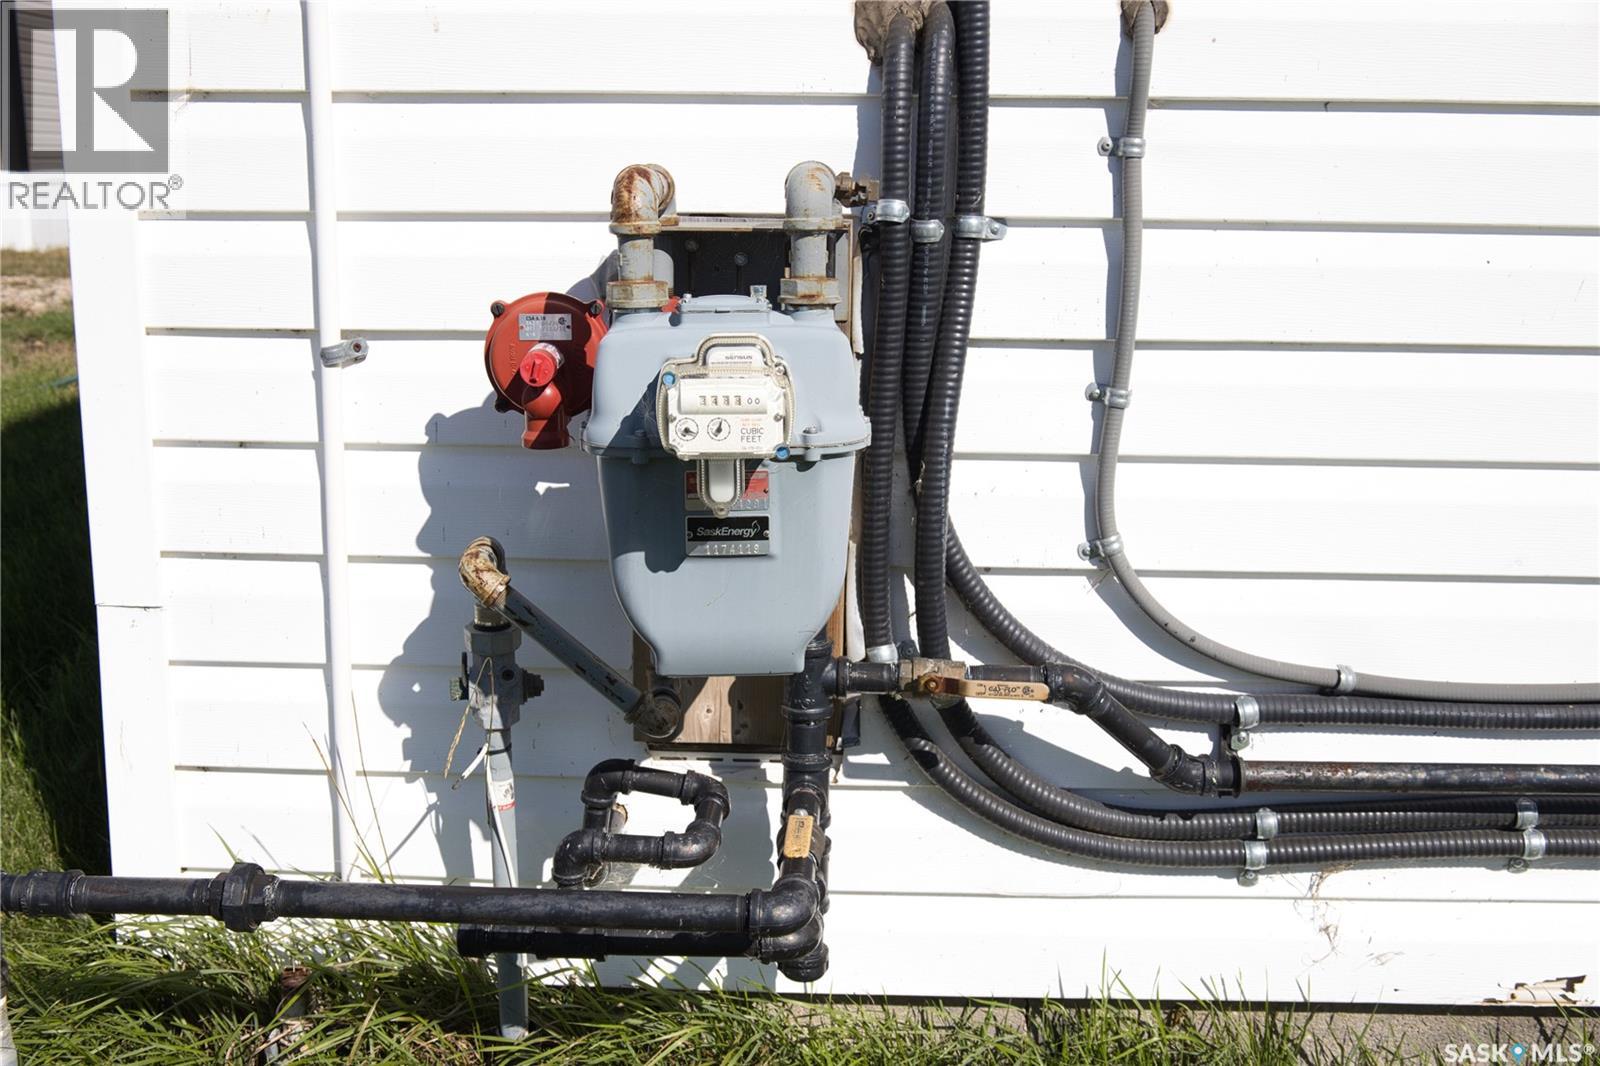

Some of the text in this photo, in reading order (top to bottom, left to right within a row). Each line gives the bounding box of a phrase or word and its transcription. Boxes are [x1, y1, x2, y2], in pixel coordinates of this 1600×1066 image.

[740, 427, 765, 435] CUBIC
[740, 435, 762, 443] FEET
[696, 526, 757, 538] SaskEnergy
